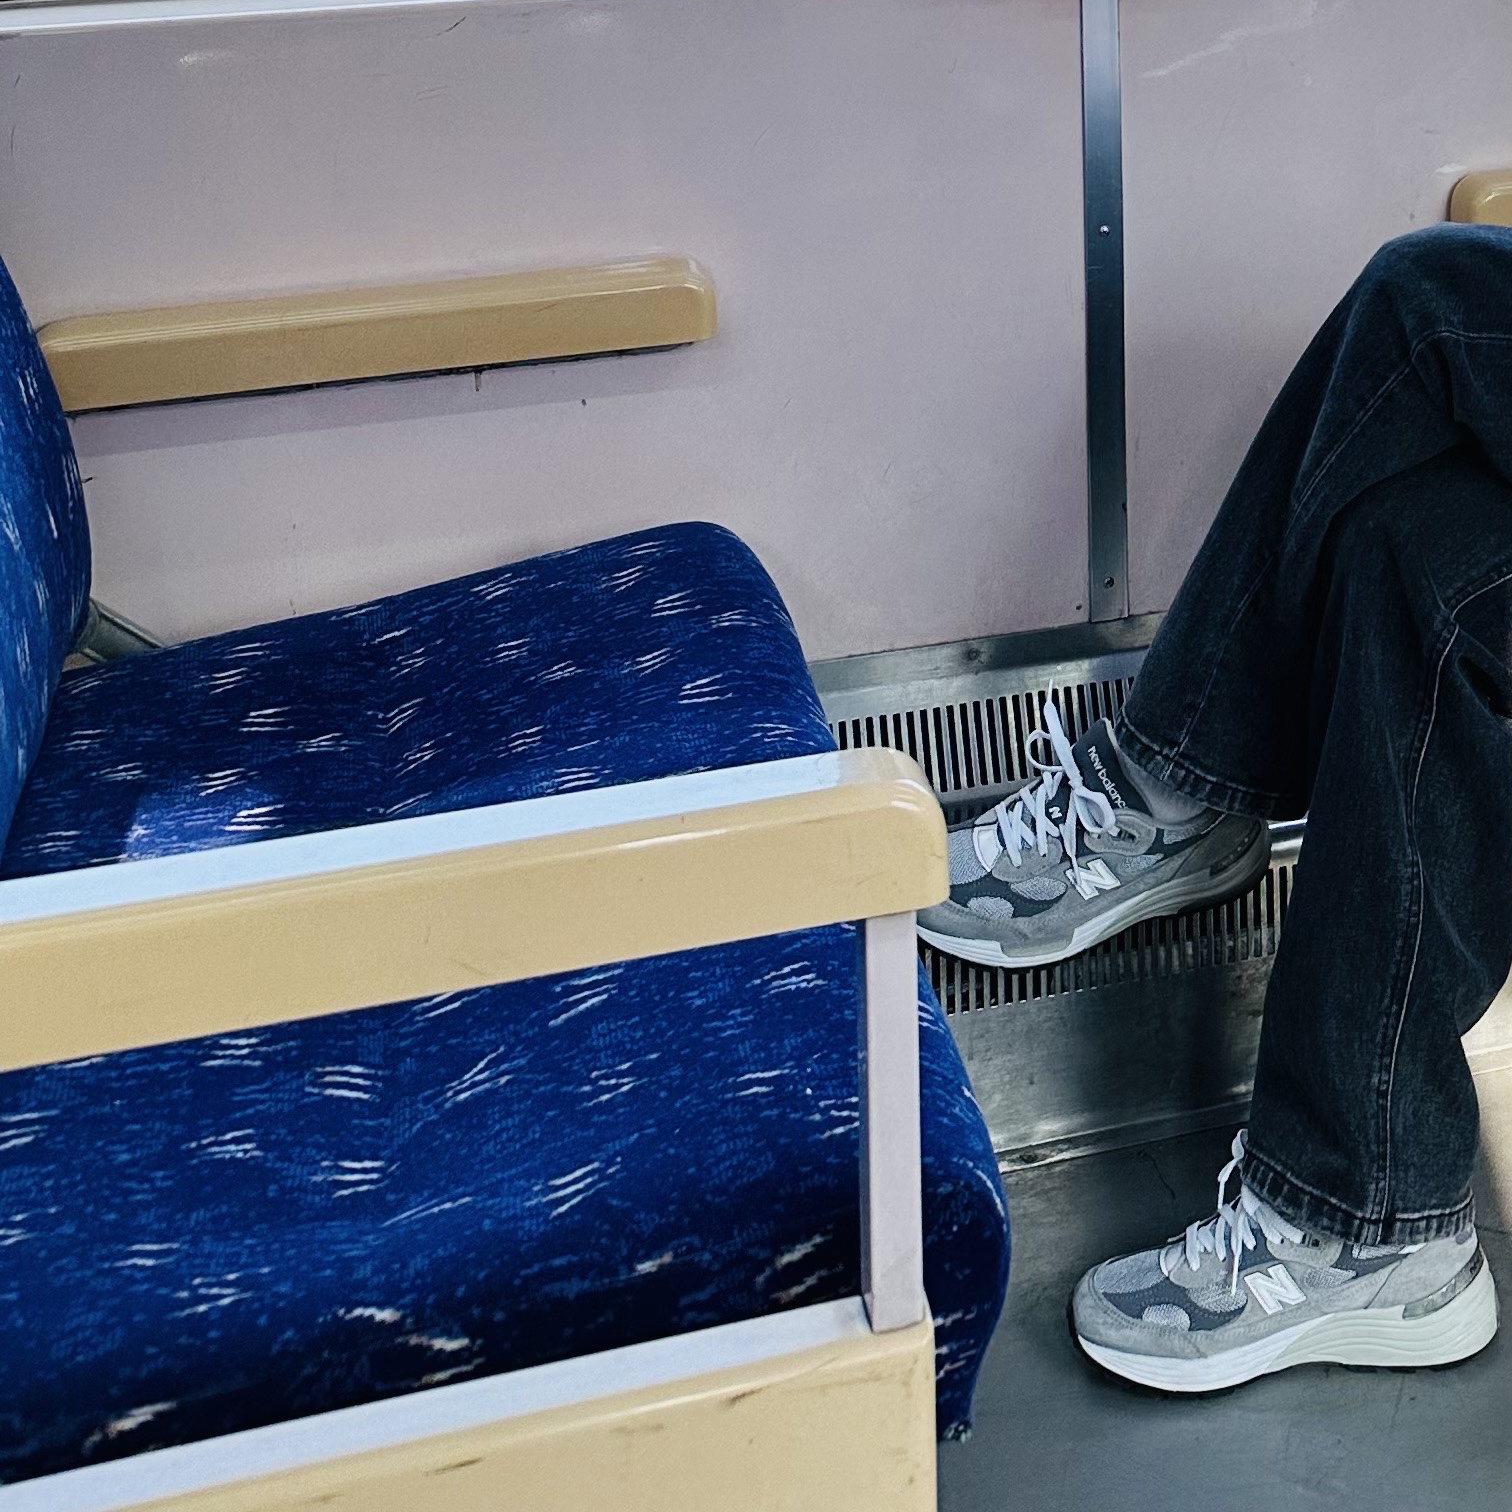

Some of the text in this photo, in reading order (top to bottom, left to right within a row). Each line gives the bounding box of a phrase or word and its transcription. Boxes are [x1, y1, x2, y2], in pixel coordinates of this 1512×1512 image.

[1087, 745, 1129, 809] new balanc
[1065, 858, 1122, 901] N
[1243, 1263, 1306, 1315] N
